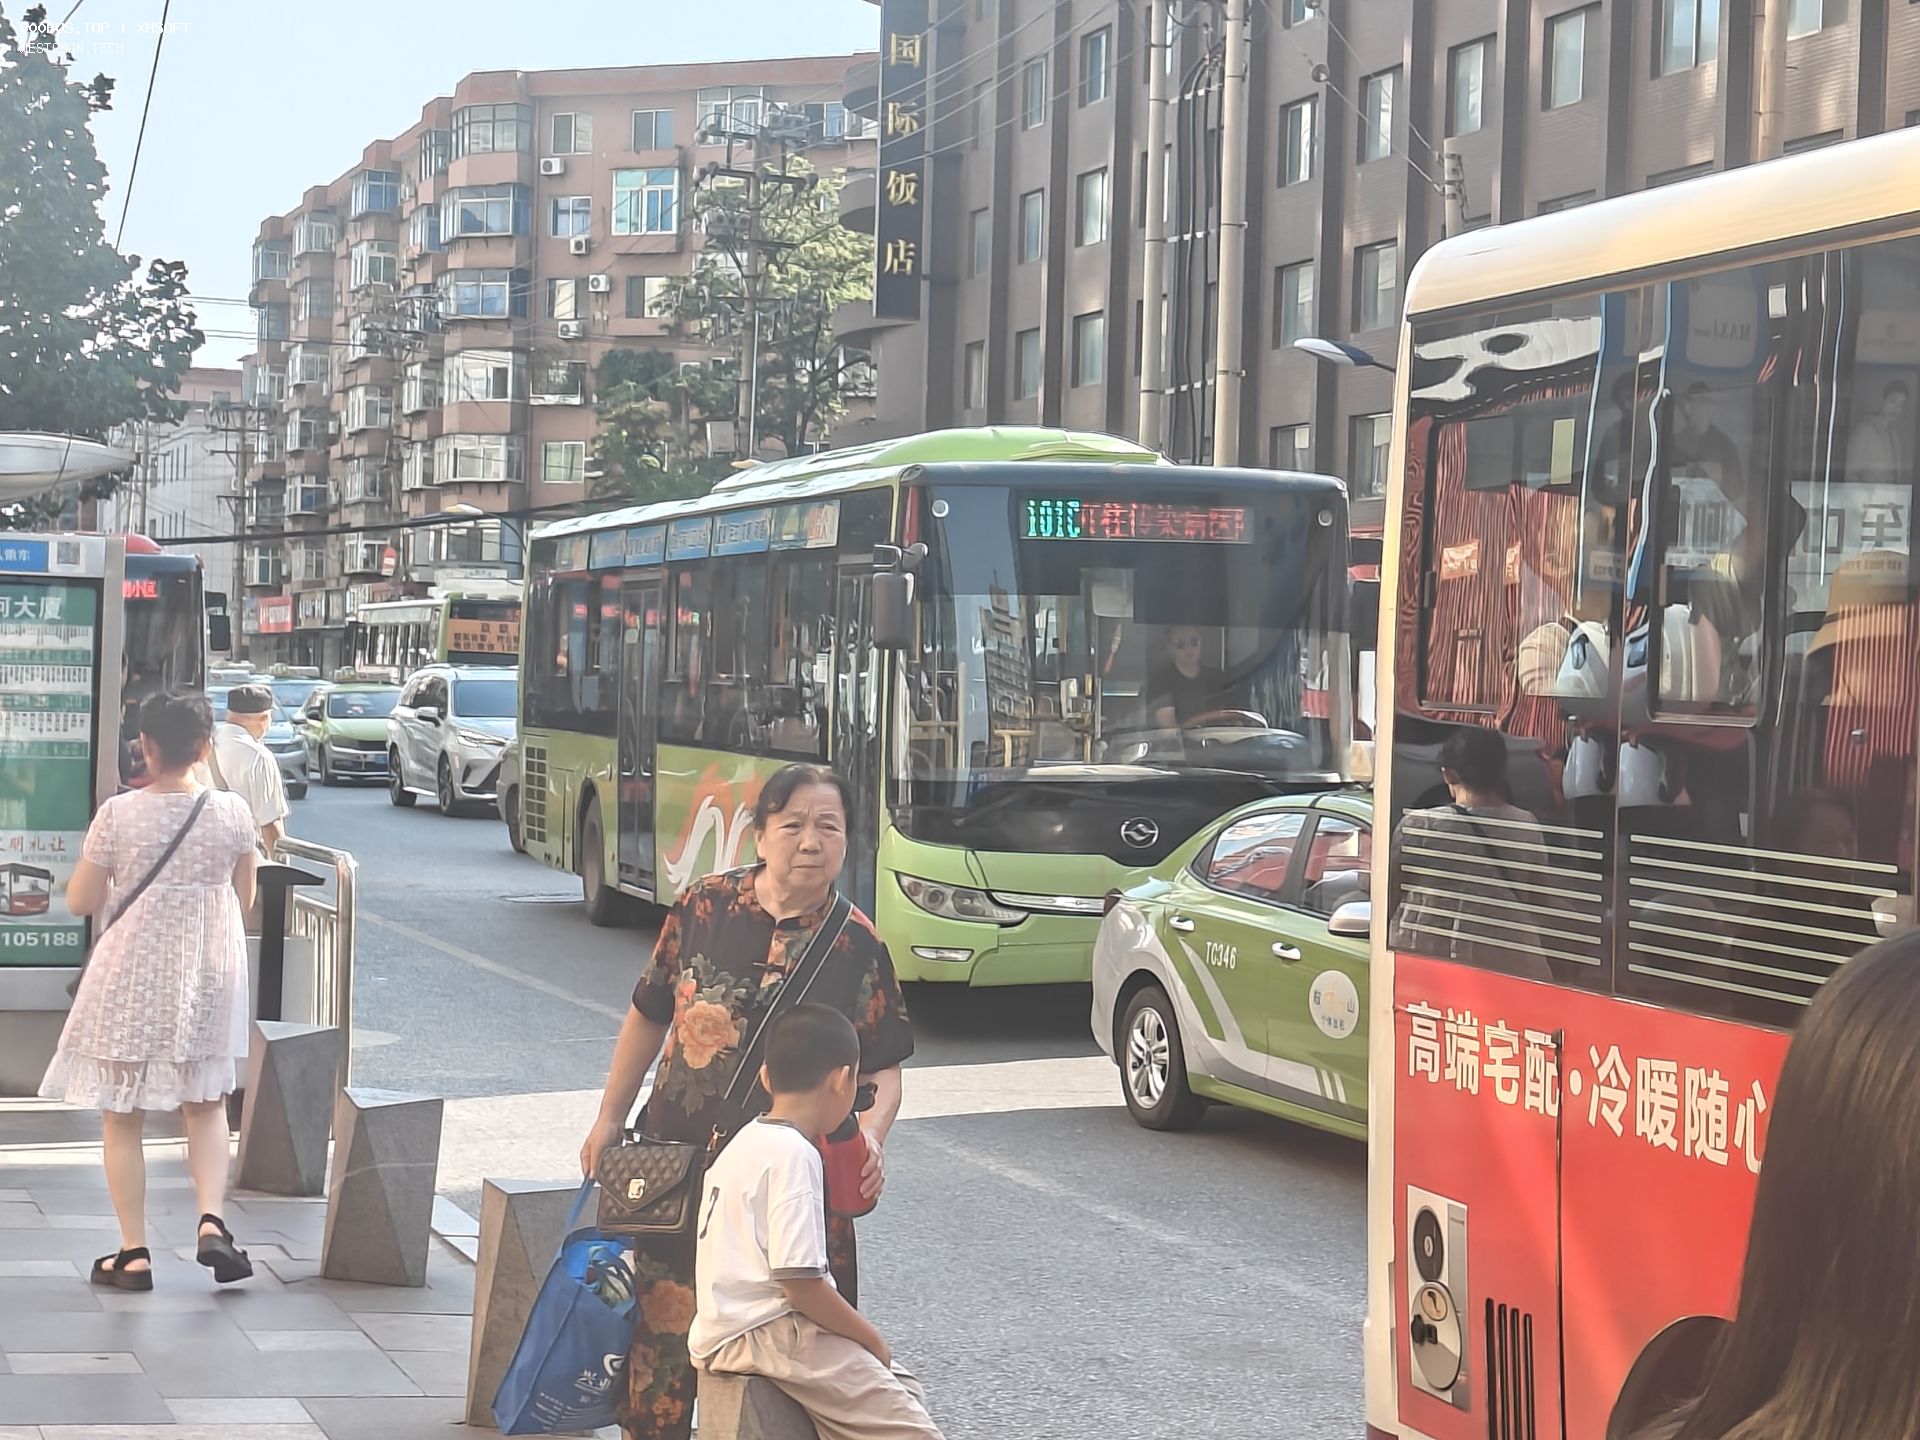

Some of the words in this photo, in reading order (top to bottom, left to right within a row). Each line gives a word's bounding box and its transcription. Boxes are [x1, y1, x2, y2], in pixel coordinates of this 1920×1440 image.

[883, 32, 921, 276] 国际饭店
[2, 931, 79, 947] 105188
[1206, 942, 1236, 970] TC346
